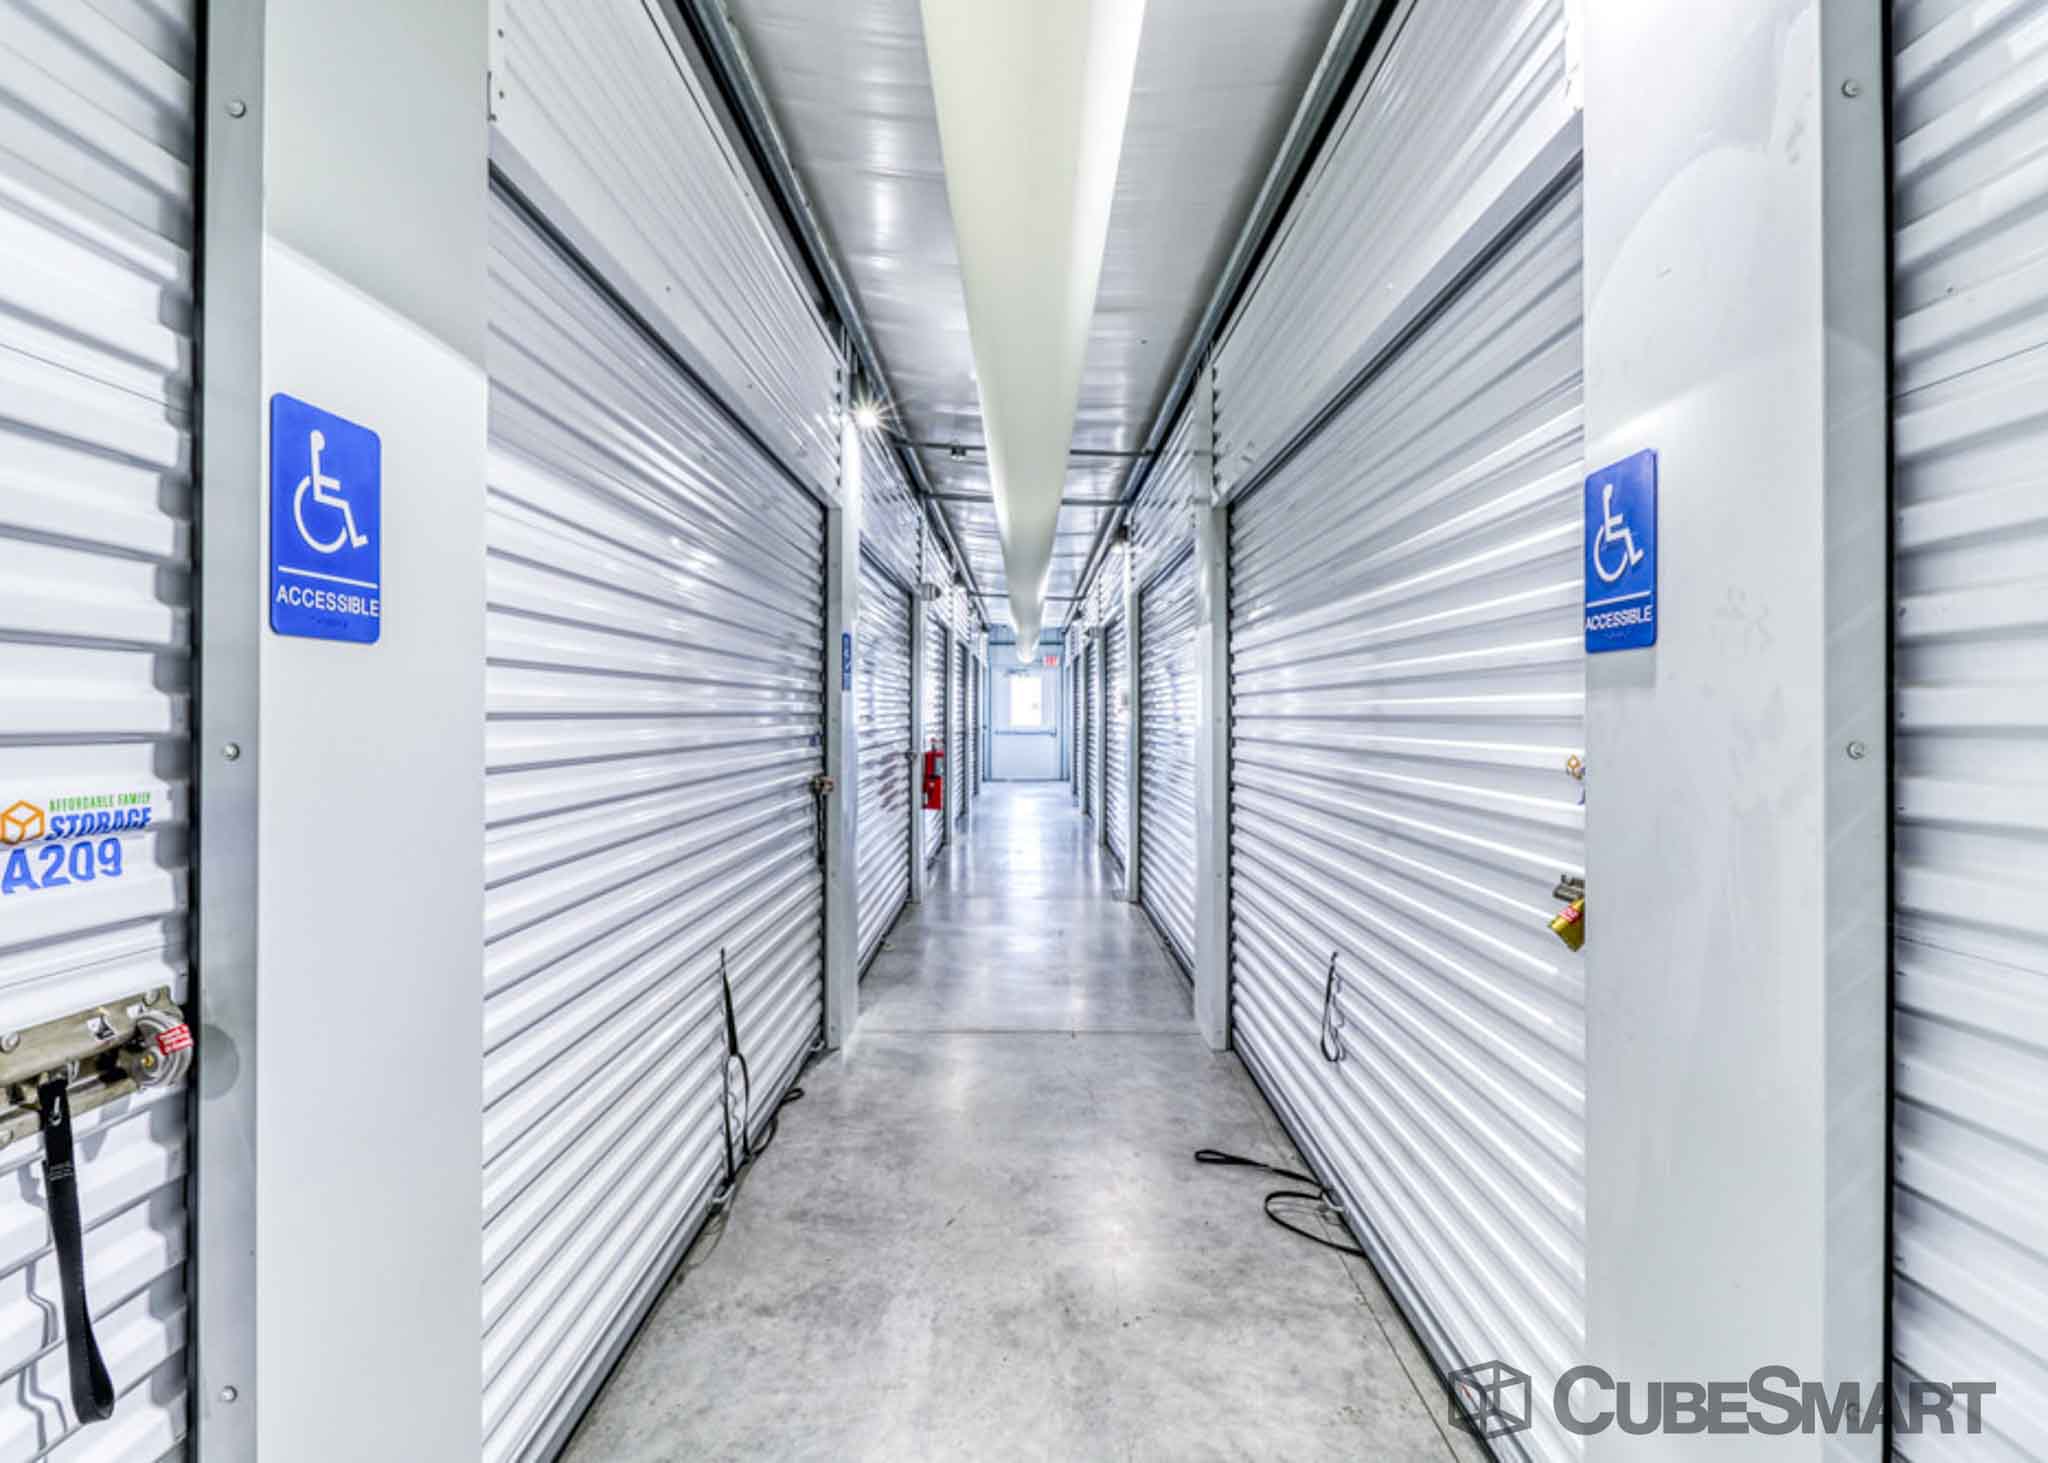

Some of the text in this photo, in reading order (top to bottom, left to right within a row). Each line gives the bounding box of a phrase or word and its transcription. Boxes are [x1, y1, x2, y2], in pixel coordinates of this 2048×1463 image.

[276, 584, 380, 617] ACCESSIBLE
[1585, 605, 1653, 630] ACCESSIBLE
[48, 795, 113, 812] AFFORDABLE
[45, 807, 152, 840] STORAGE
[1, 838, 123, 895] A209
